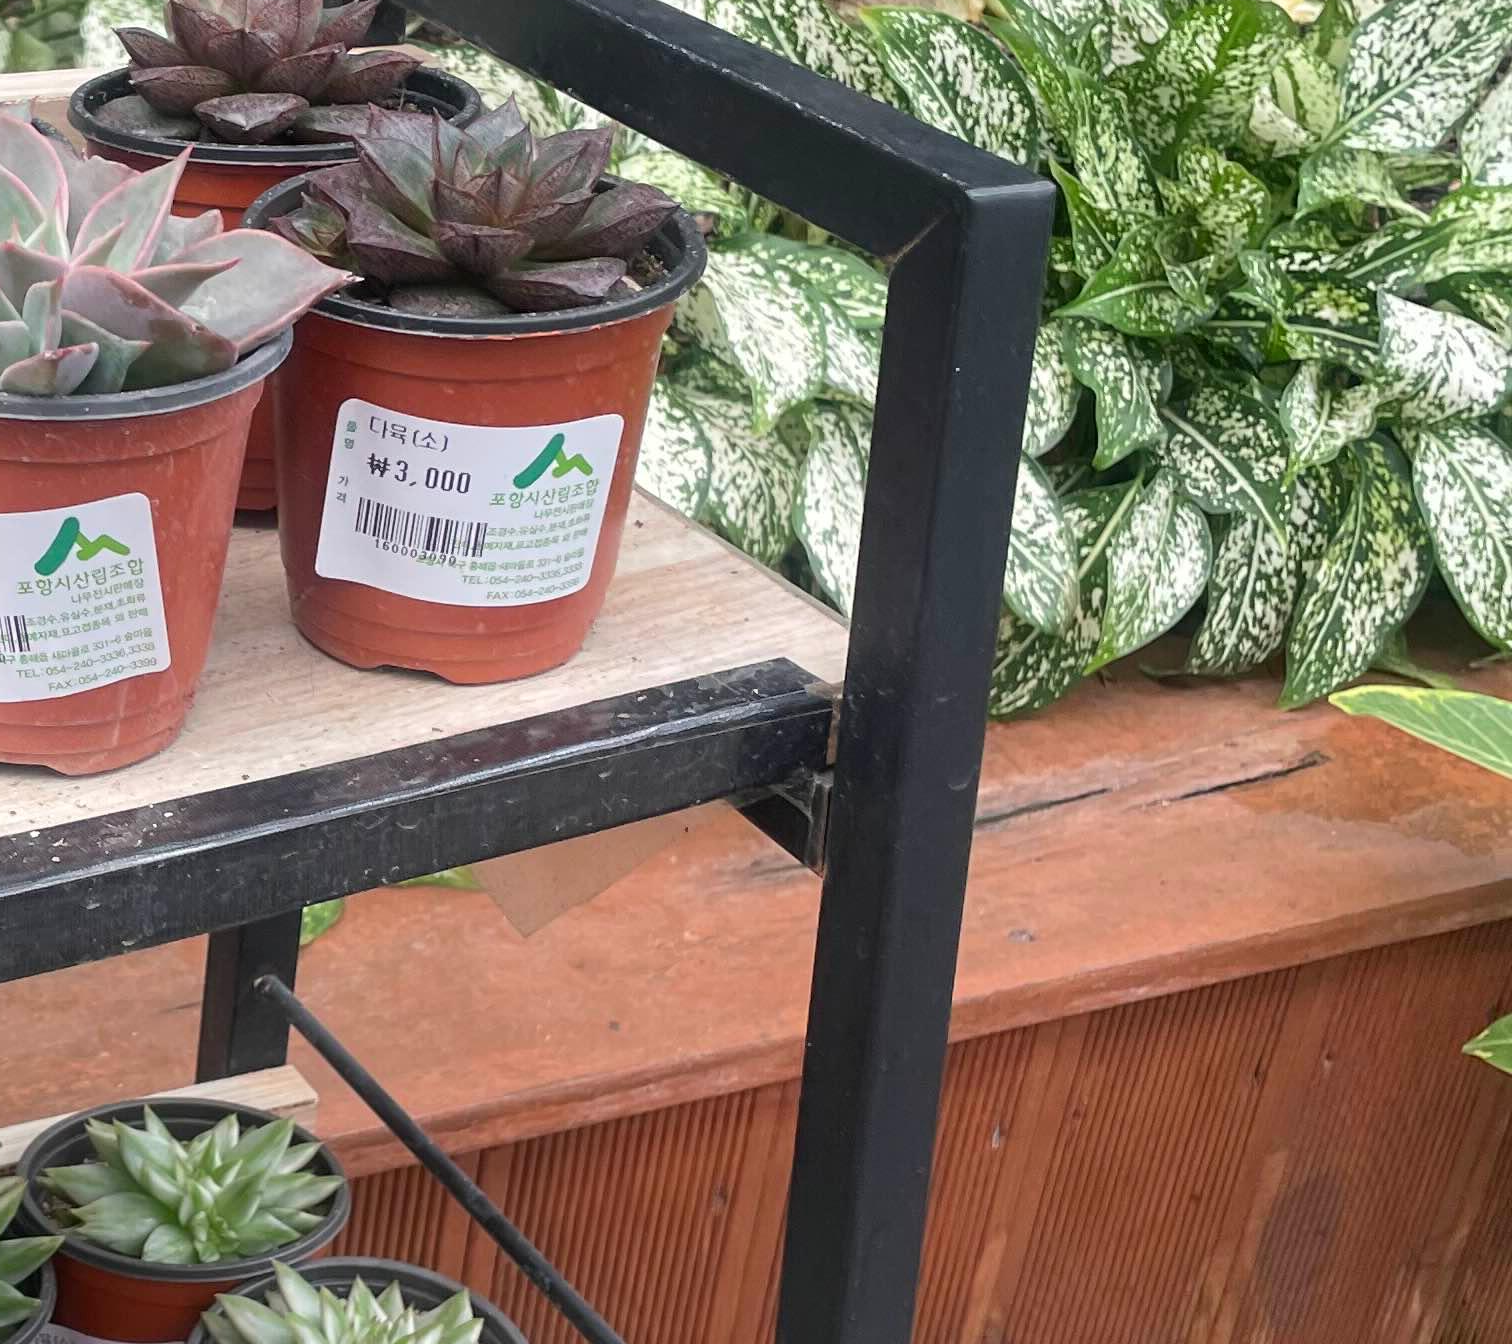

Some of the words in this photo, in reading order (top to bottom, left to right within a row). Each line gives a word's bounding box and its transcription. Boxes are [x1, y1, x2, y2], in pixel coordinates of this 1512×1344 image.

[368, 415, 450, 453] 다육(소)
[366, 452, 472, 494] ₩3,000
[16, 558, 145, 597] 포항시산림조합
